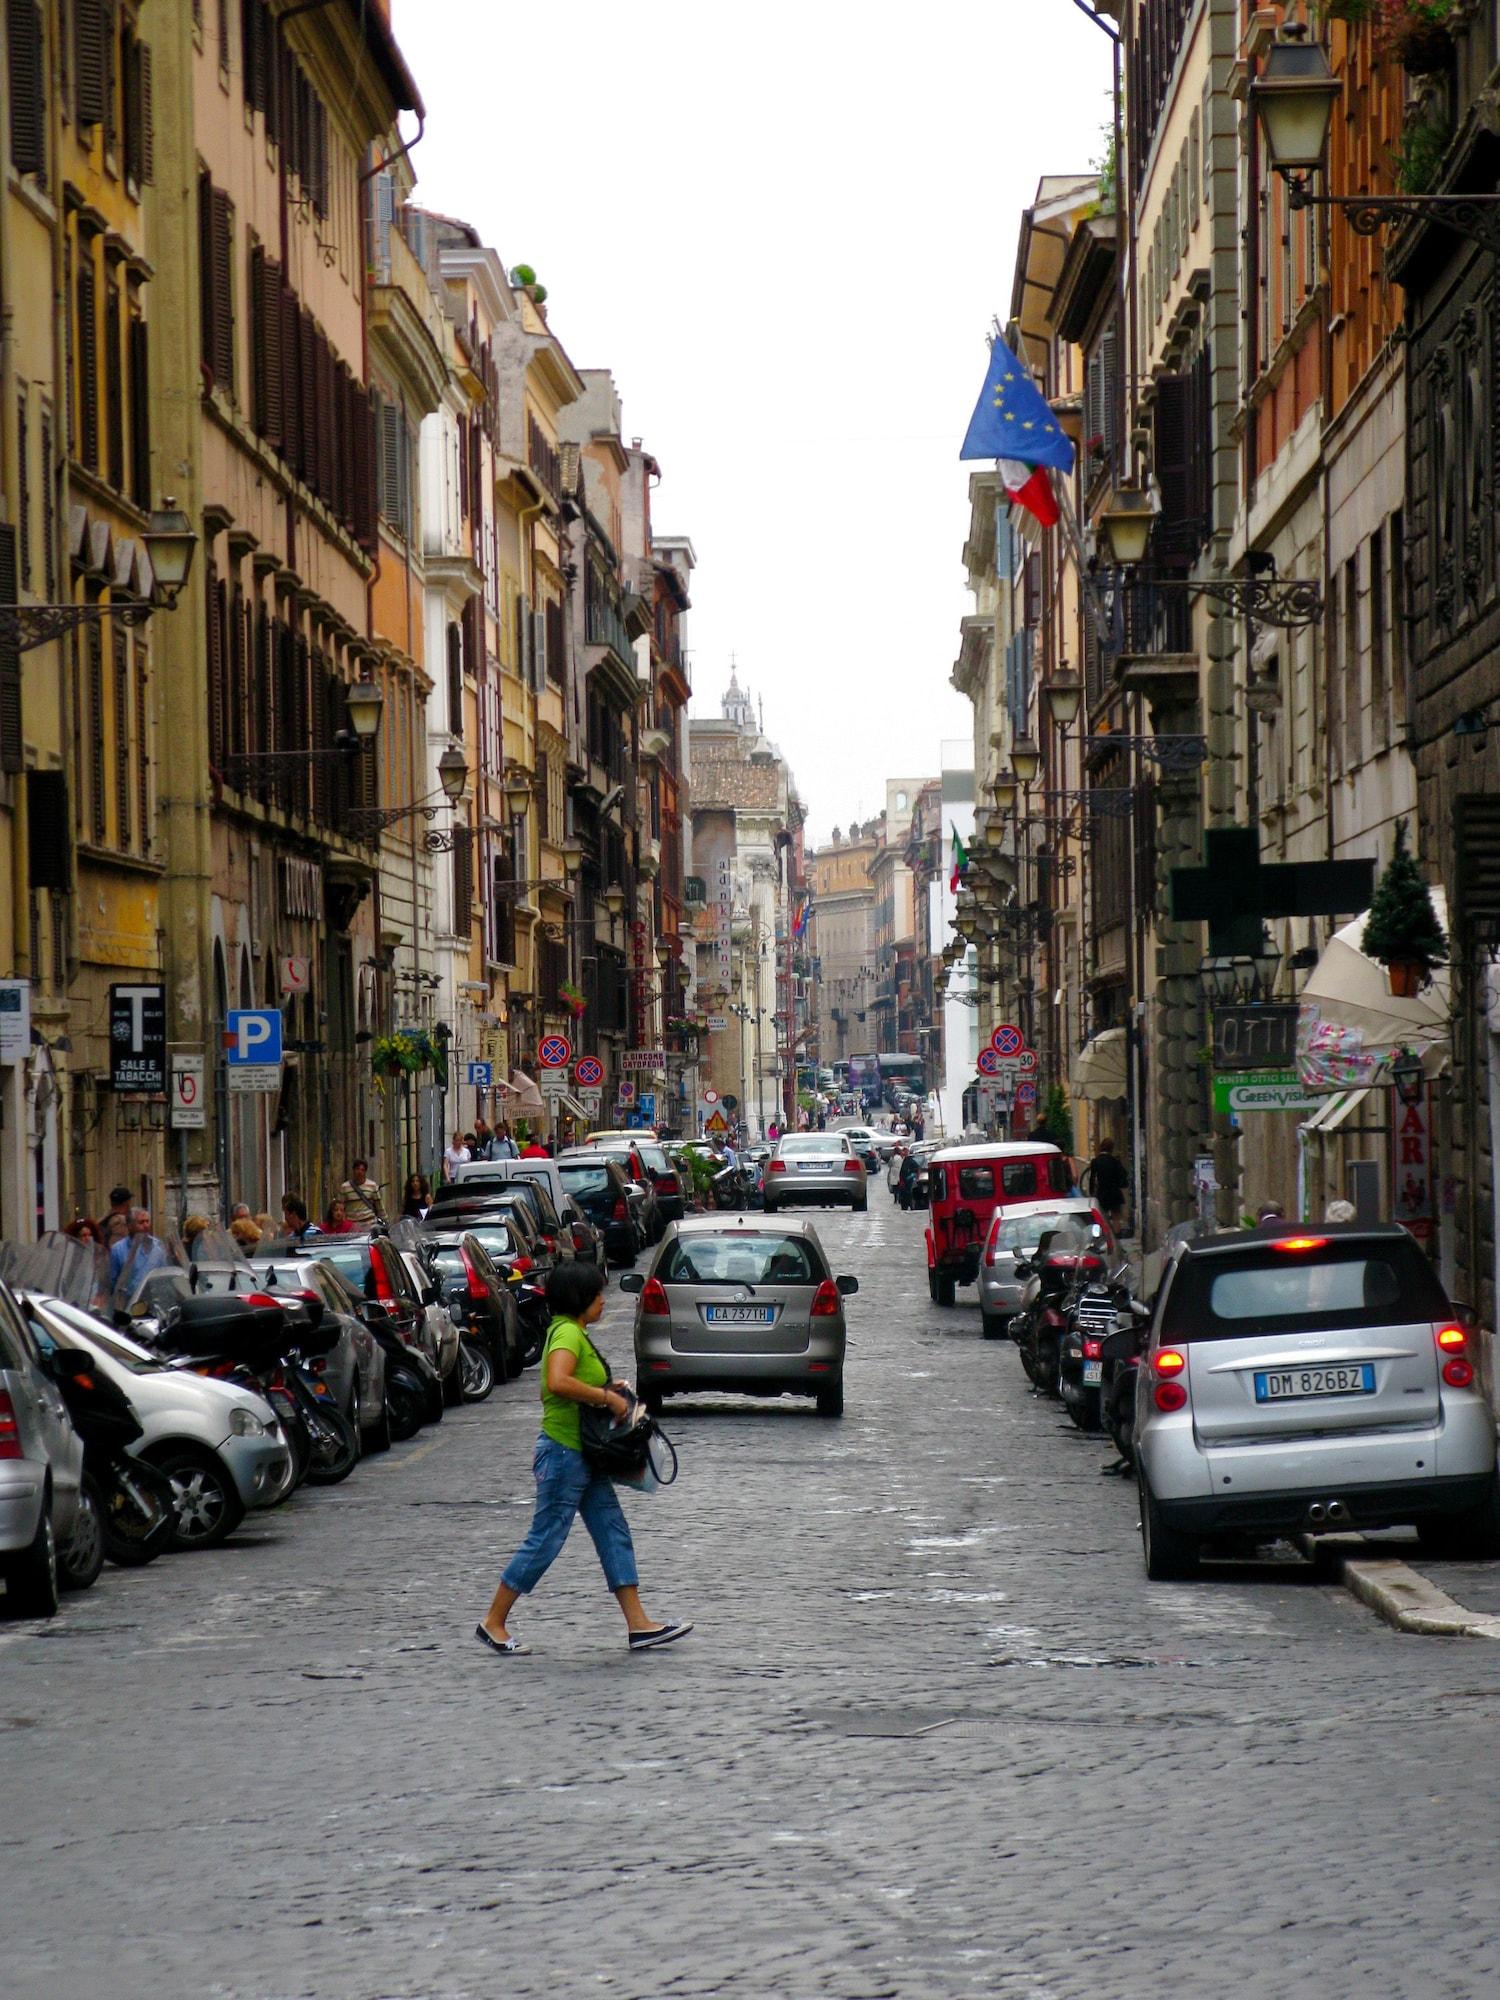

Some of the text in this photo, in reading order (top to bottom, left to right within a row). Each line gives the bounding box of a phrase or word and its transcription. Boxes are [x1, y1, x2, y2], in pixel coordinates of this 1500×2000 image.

[115, 987, 160, 1052] T
[238, 1016, 271, 1059] P
[120, 1060, 156, 1070] SALE E
[1020, 1055, 1033, 1065] 30
[115, 1071, 162, 1081] TABACCHI
[1217, 1076, 1248, 1084] CENTRI
[1400, 1083, 1424, 1165] AR
[715, 1308, 766, 1319] CA 737TH
[1270, 1369, 1361, 1395] DM 826BZ
